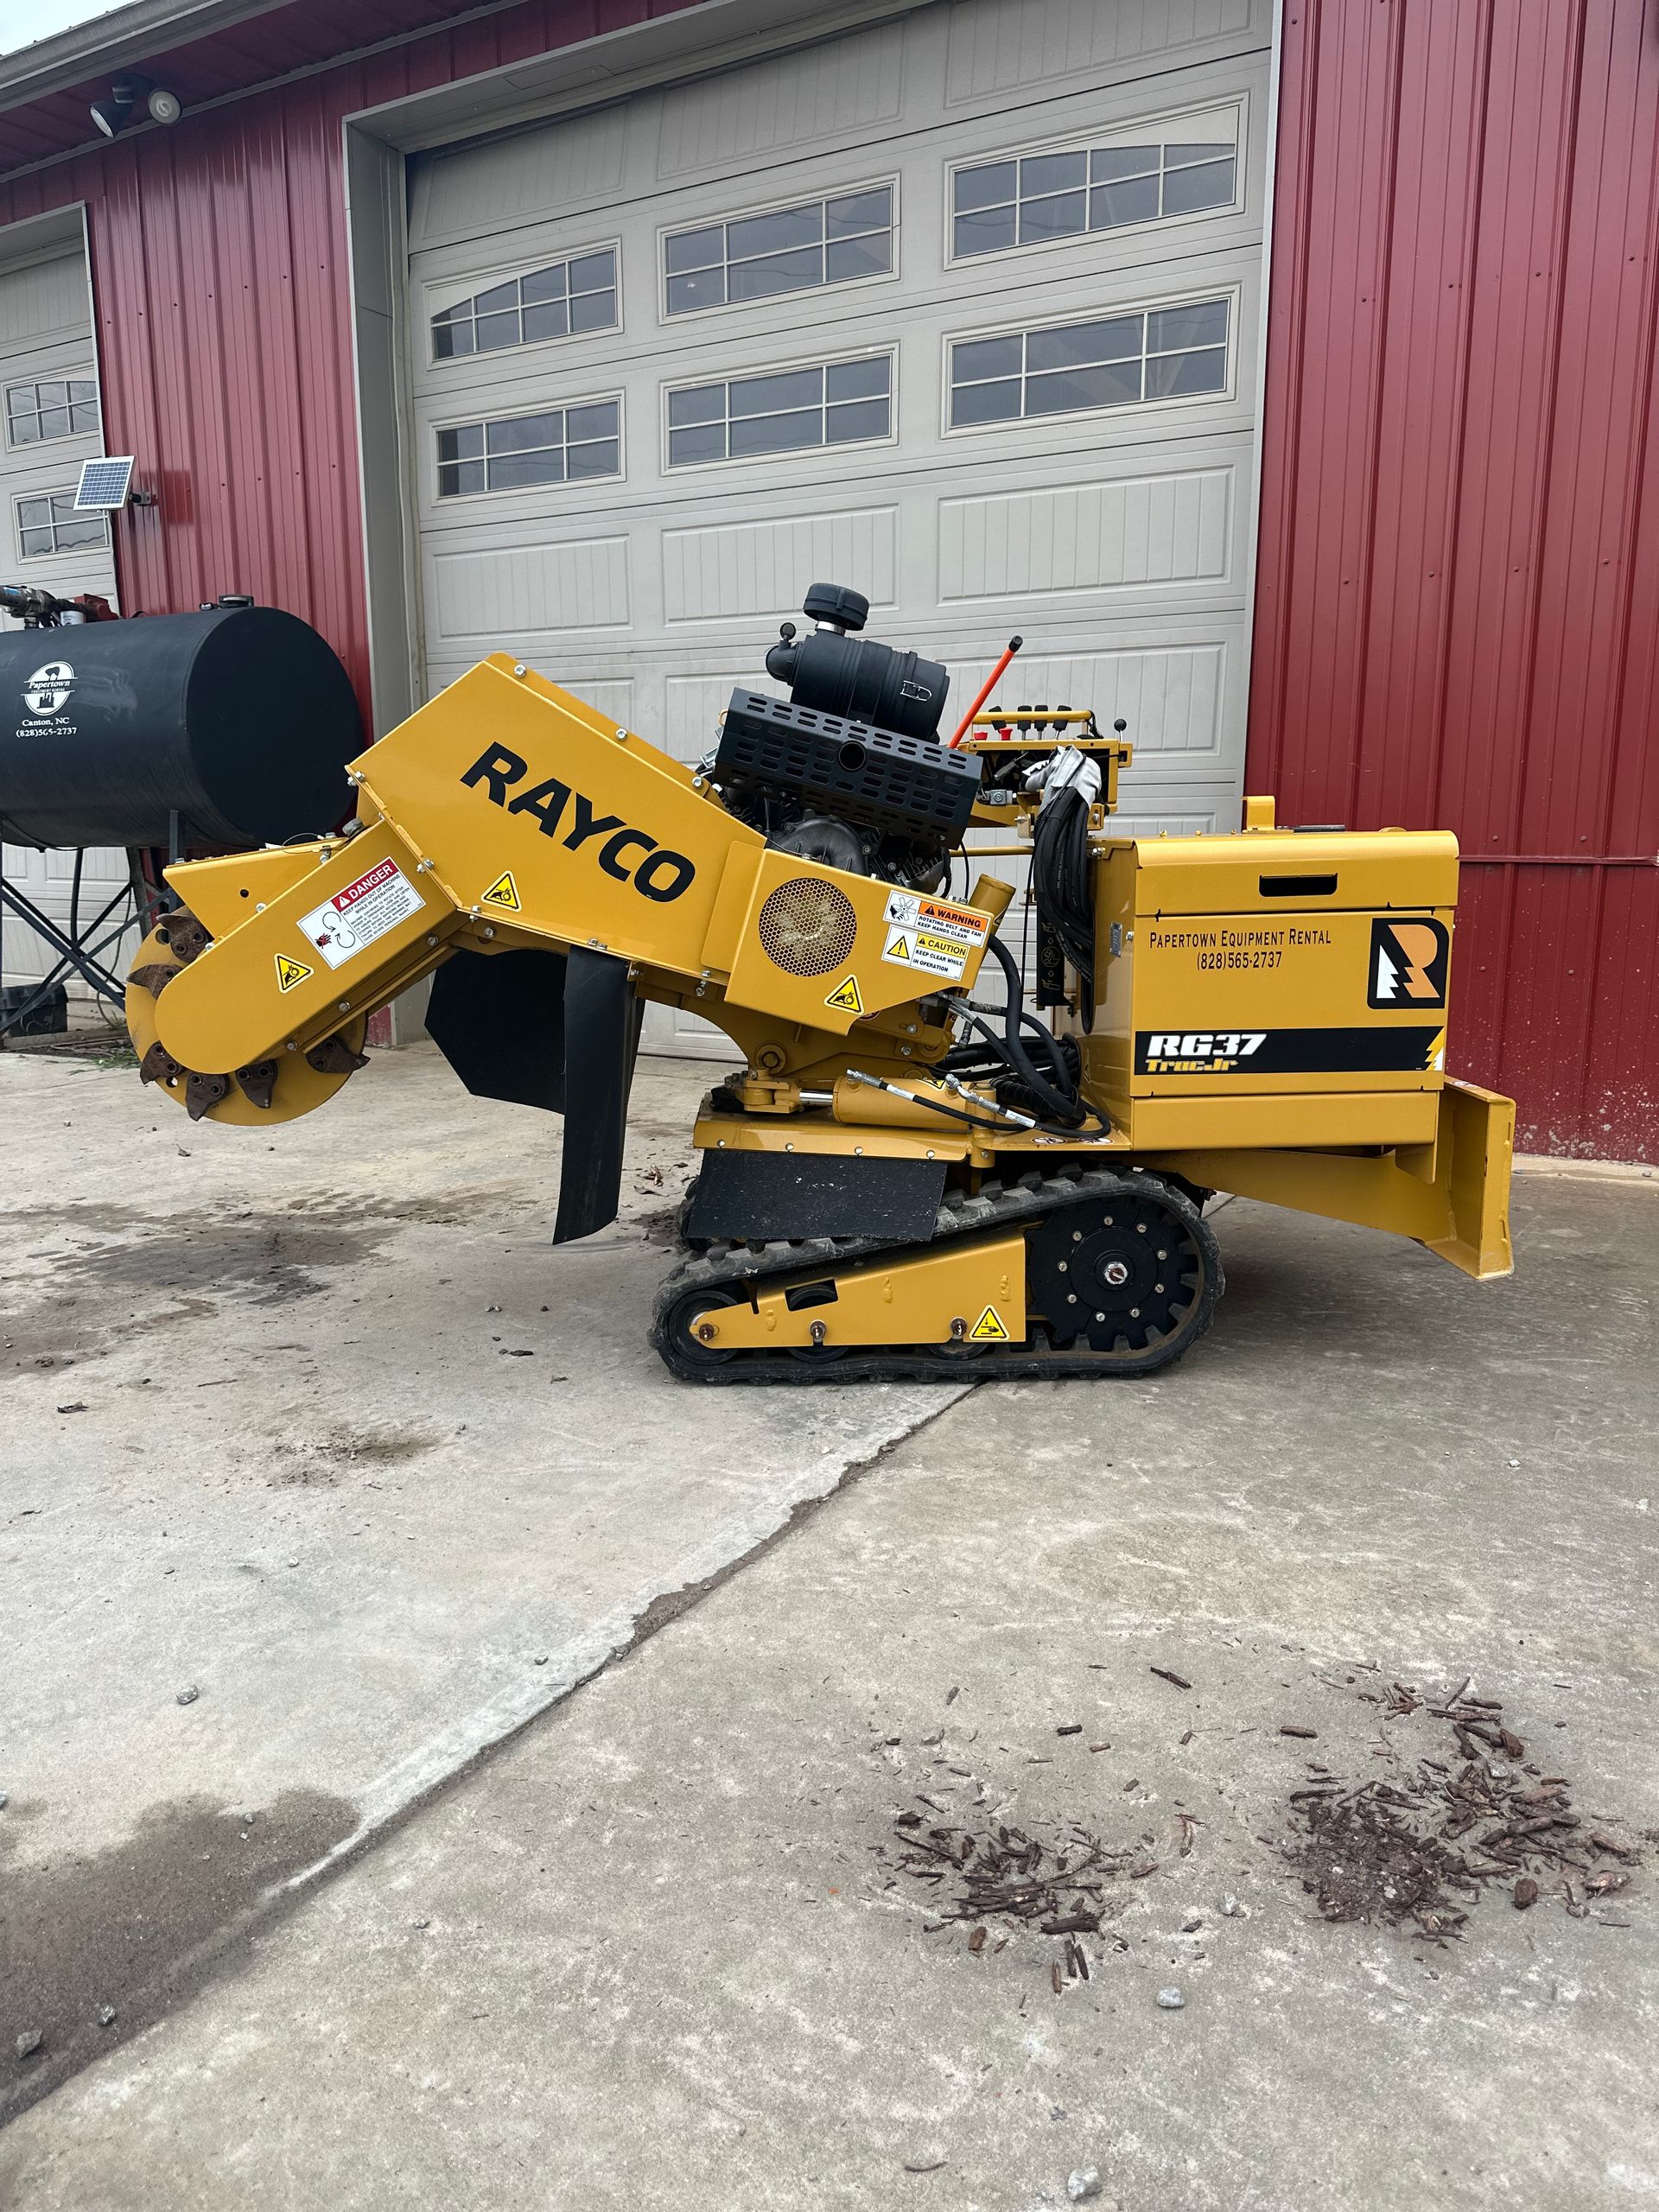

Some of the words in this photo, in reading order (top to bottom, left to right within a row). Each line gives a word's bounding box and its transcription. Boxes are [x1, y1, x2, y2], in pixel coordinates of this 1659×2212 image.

[29, 681, 70, 690] Papertown
[16, 728, 77, 738] (828)565-2737
[460, 741, 696, 902] RAYCO
[348, 865, 393, 899] DANGER
[919, 916, 944, 926] ROTATING
[938, 909, 982, 928] WARNING
[928, 940, 966, 956] CAUTION
[920, 961, 949, 972] OPERATION
[930, 953, 945, 962] CLEAR
[948, 957, 963, 966] WHILE
[1197, 951, 1282, 969] (828)565-2737
[1147, 1033, 1267, 1056] RG37
